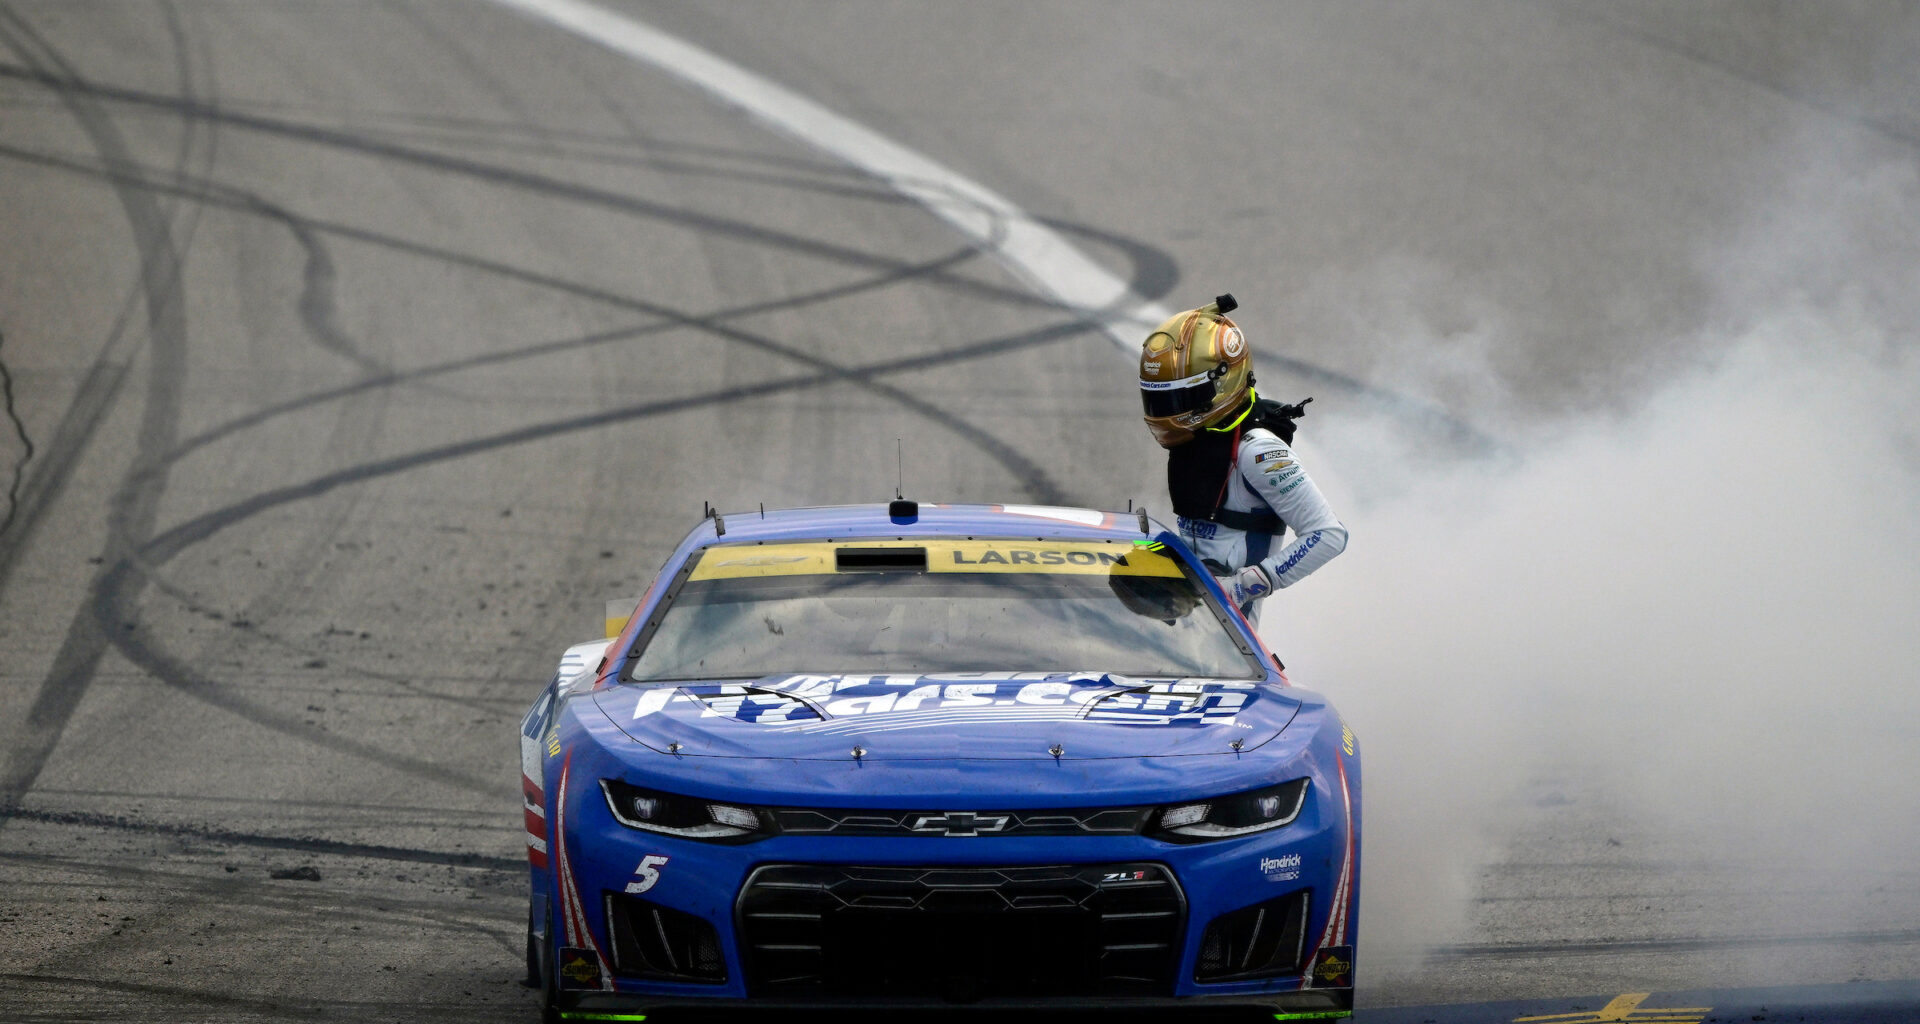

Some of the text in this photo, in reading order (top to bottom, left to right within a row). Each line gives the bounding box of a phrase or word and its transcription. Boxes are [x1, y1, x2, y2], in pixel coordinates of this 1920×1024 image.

[1264, 450, 1288, 460] NASCAR
[1279, 465, 1300, 482] Atrium
[1280, 476, 1305, 495] SIEMENS
[953, 550, 1129, 567] LARSON
[1260, 853, 1301, 875] Hendrick
[625, 854, 669, 894] 5
[1102, 871, 1145, 882] ZL1
